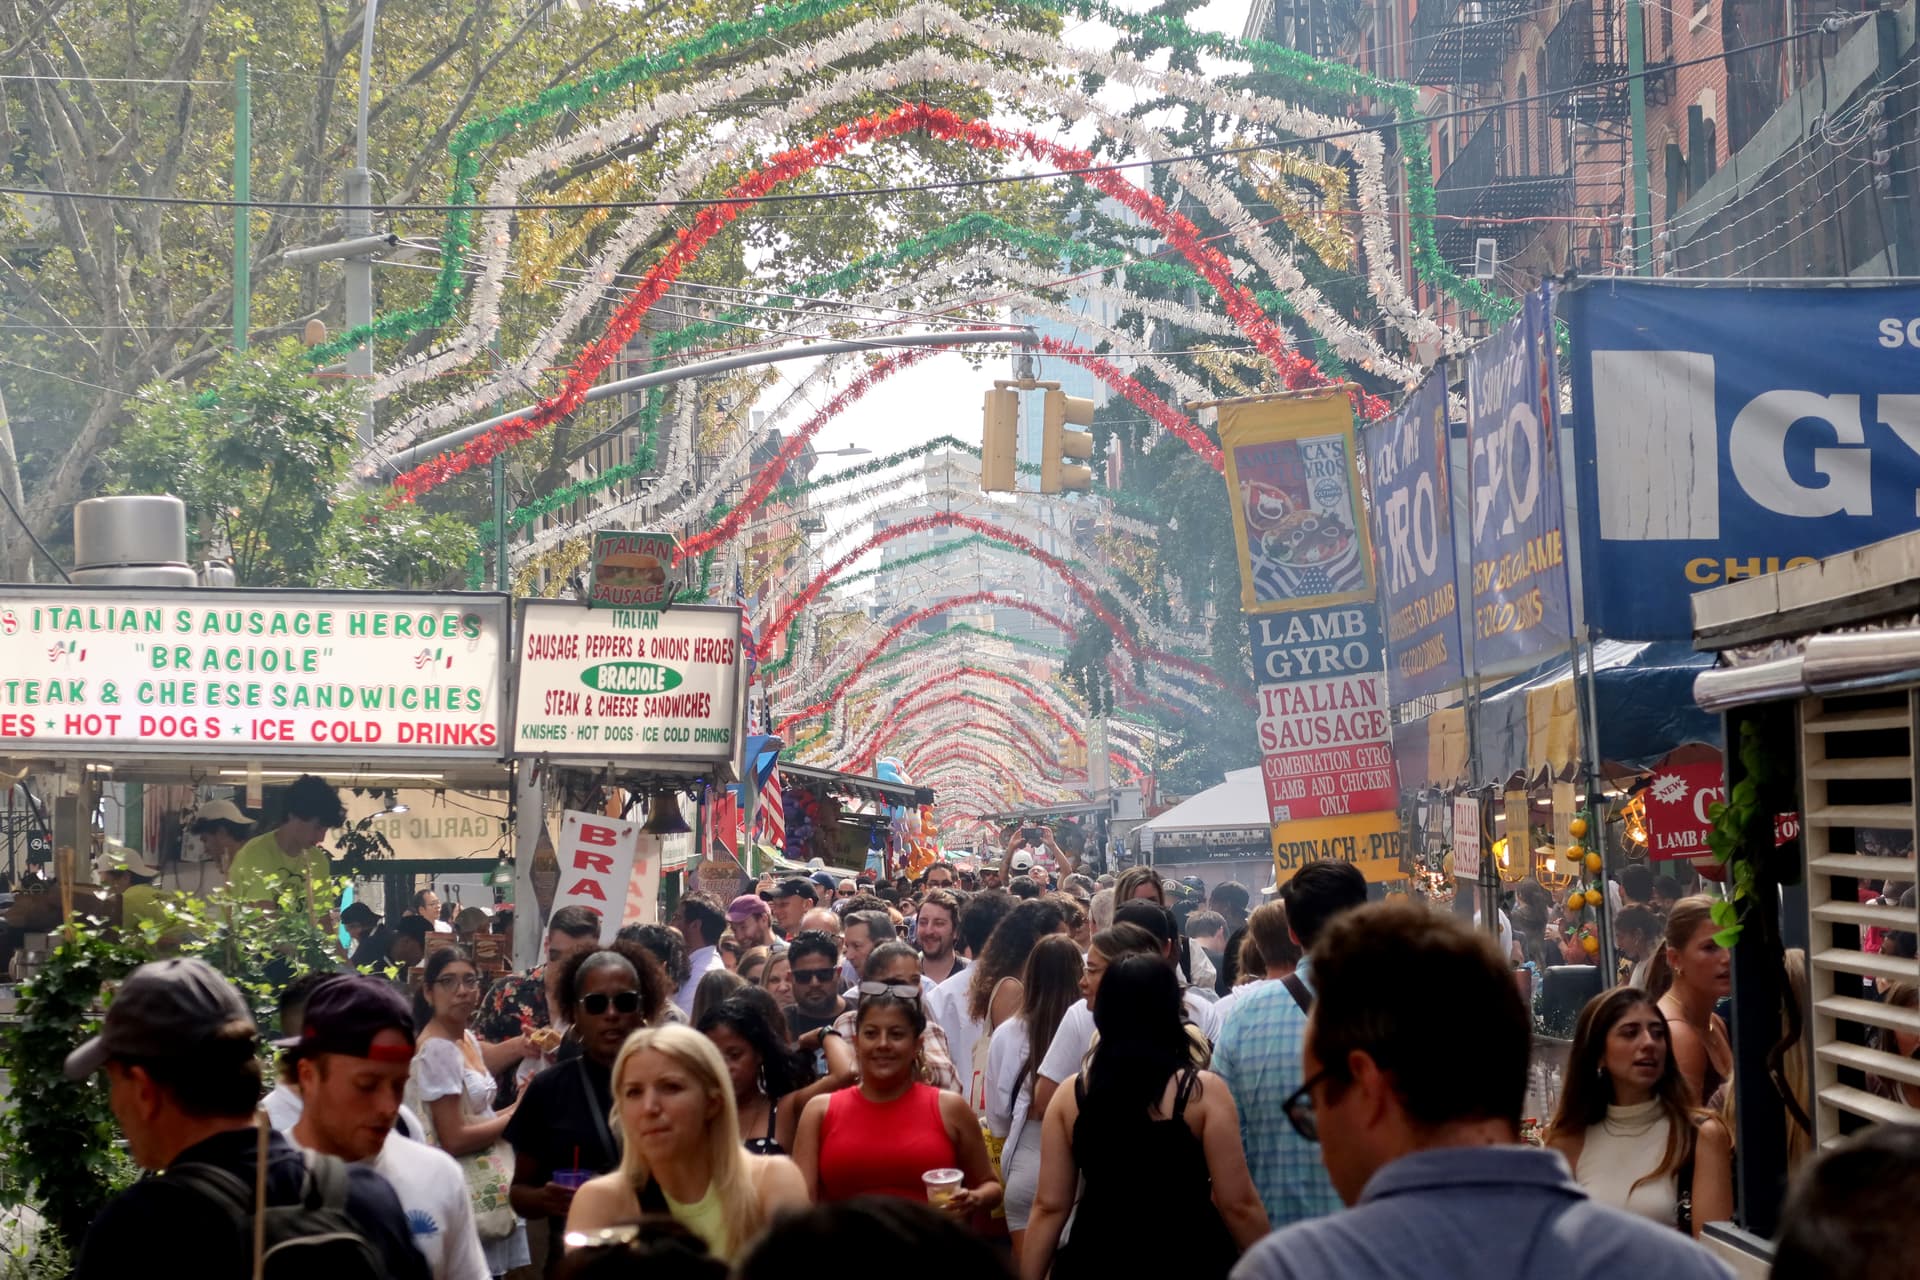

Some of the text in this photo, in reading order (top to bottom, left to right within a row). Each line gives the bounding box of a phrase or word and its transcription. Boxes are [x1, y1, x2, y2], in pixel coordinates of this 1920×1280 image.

[598, 535, 670, 561] ITALIAN
[592, 582, 664, 605] SAUSAGE
[33, 606, 163, 632] ITALIAN
[176, 608, 333, 635] SAUSAGE
[349, 612, 482, 639] HEROES
[612, 610, 658, 630] ITALIAN
[1259, 609, 1367, 647] LAMB
[528, 634, 734, 665] SAUSAGE, PEPPERS & ONIONS HEROES
[1265, 641, 1369, 678] GYRO
[598, 665, 666, 692] BRACIOLE
[5, 680, 481, 711] TEAK & CHEESE SANDWICHES
[544, 690, 711, 718] STEAK & CHEESE SANDWICHES
[1263, 678, 1377, 717] ITALIAN
[1, 714, 496, 746] ES HOT DOGS ICE COLD DRINKS
[521, 724, 730, 744] KNISHES HOT DOGS ICE COLD DRINKS
[1261, 710, 1387, 750] SAUSAGE
[1266, 745, 1391, 778] COMBINATION GYRO
[1272, 769, 1392, 801] LAMB AND CHICKEN
[1659, 781, 1682, 798] NEW
[1320, 795, 1350, 816] ONLY
[1278, 836, 1357, 869] SPINACH
[1369, 831, 1401, 860] PIE
[1656, 830, 1698, 850] LAMB
[566, 823, 618, 918] BRA
